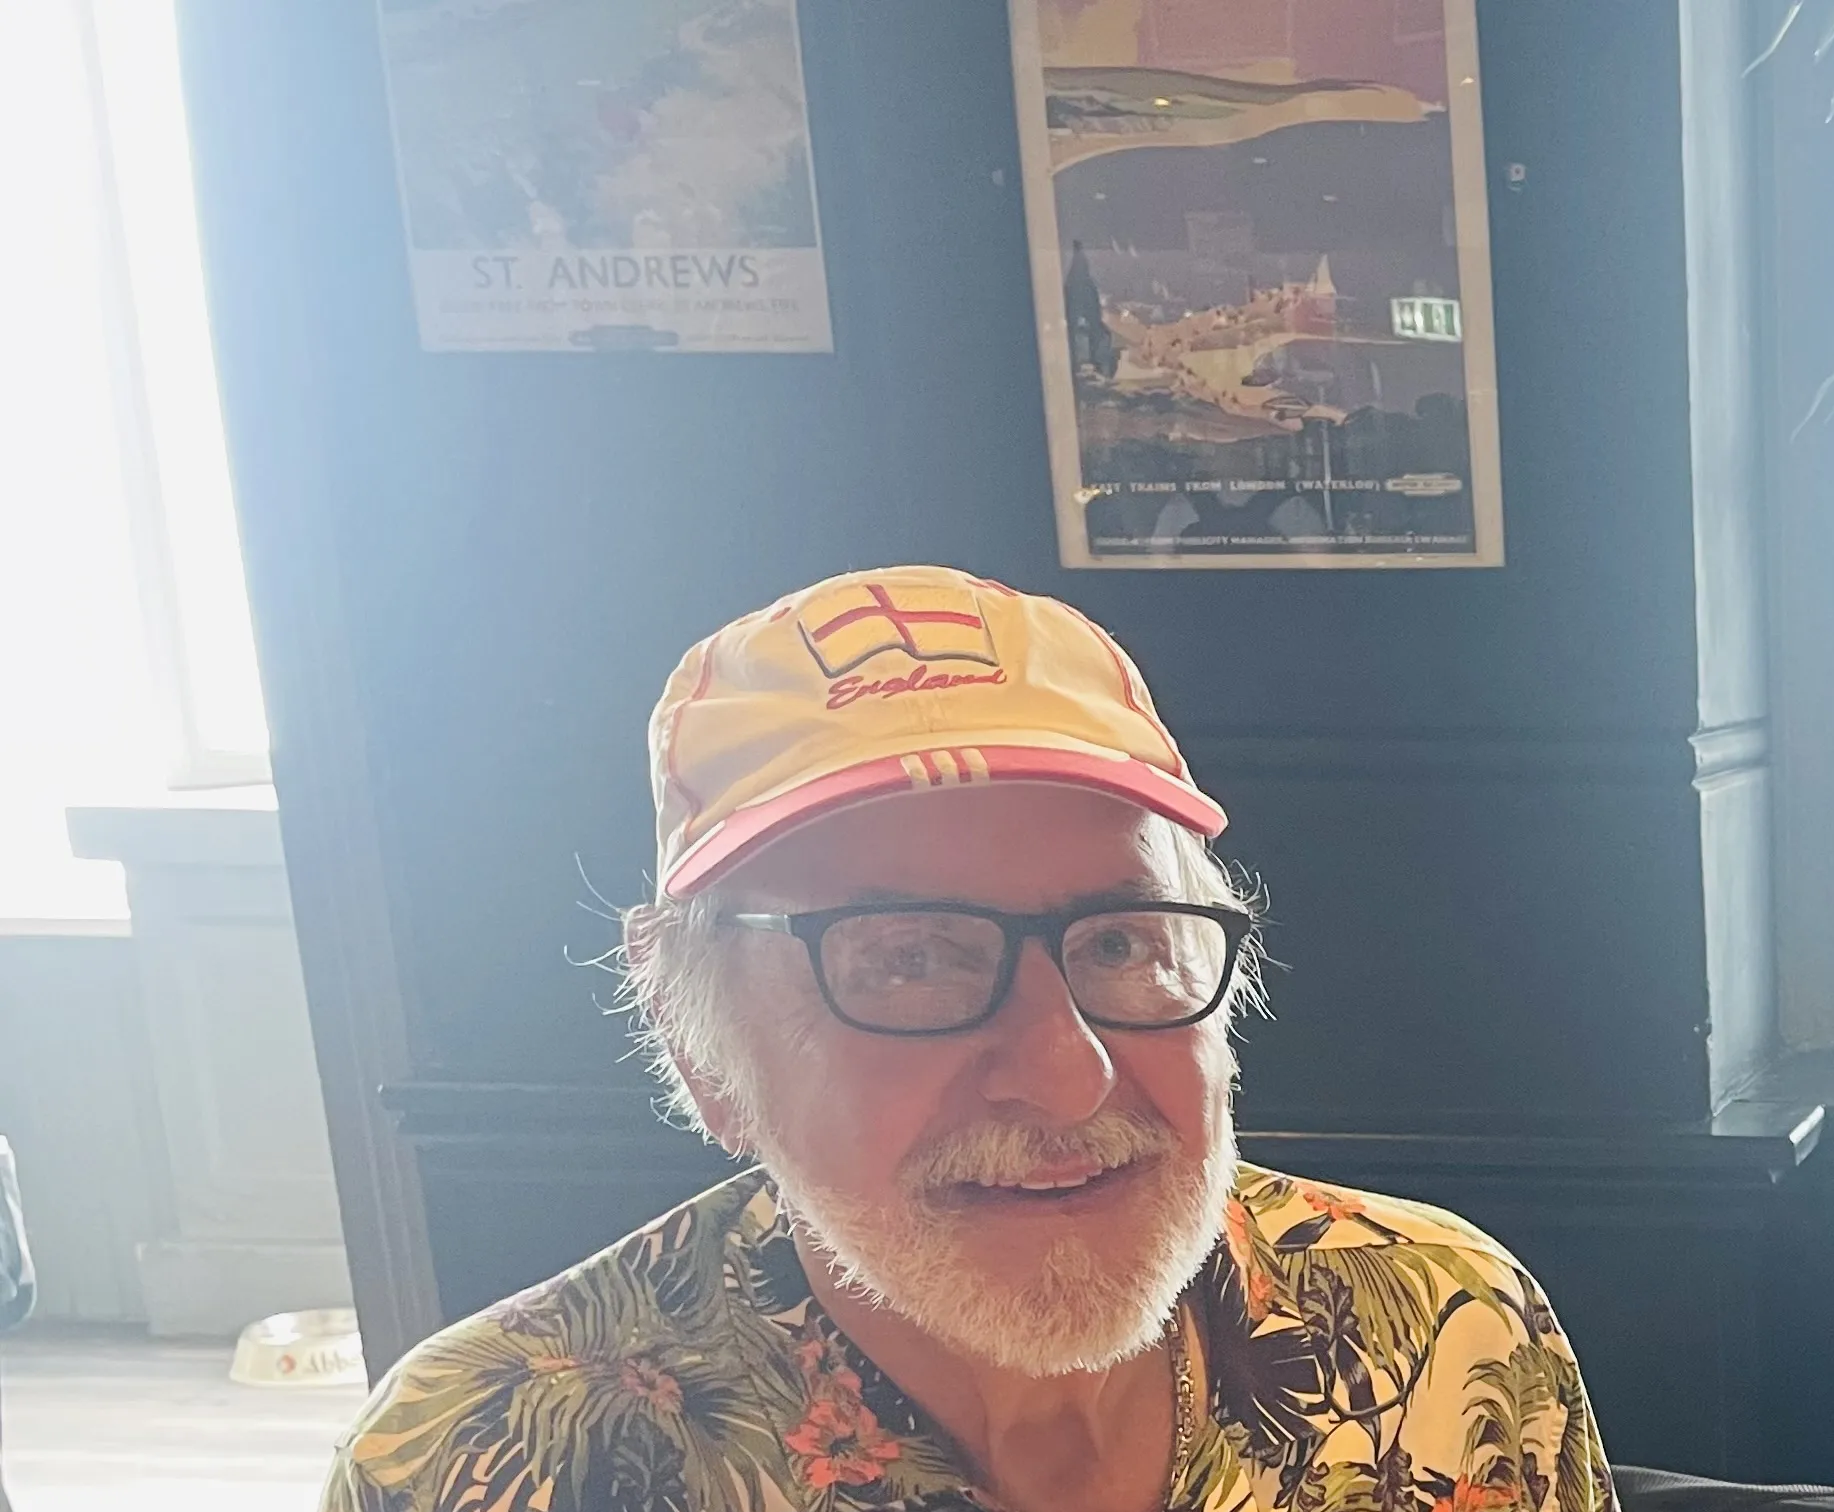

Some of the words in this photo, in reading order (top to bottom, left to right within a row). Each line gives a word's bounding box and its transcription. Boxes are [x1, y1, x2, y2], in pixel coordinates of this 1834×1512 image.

[471, 256, 522, 289] ST.
[548, 255, 761, 289] ANDREWS
[826, 664, 1007, 710] England
